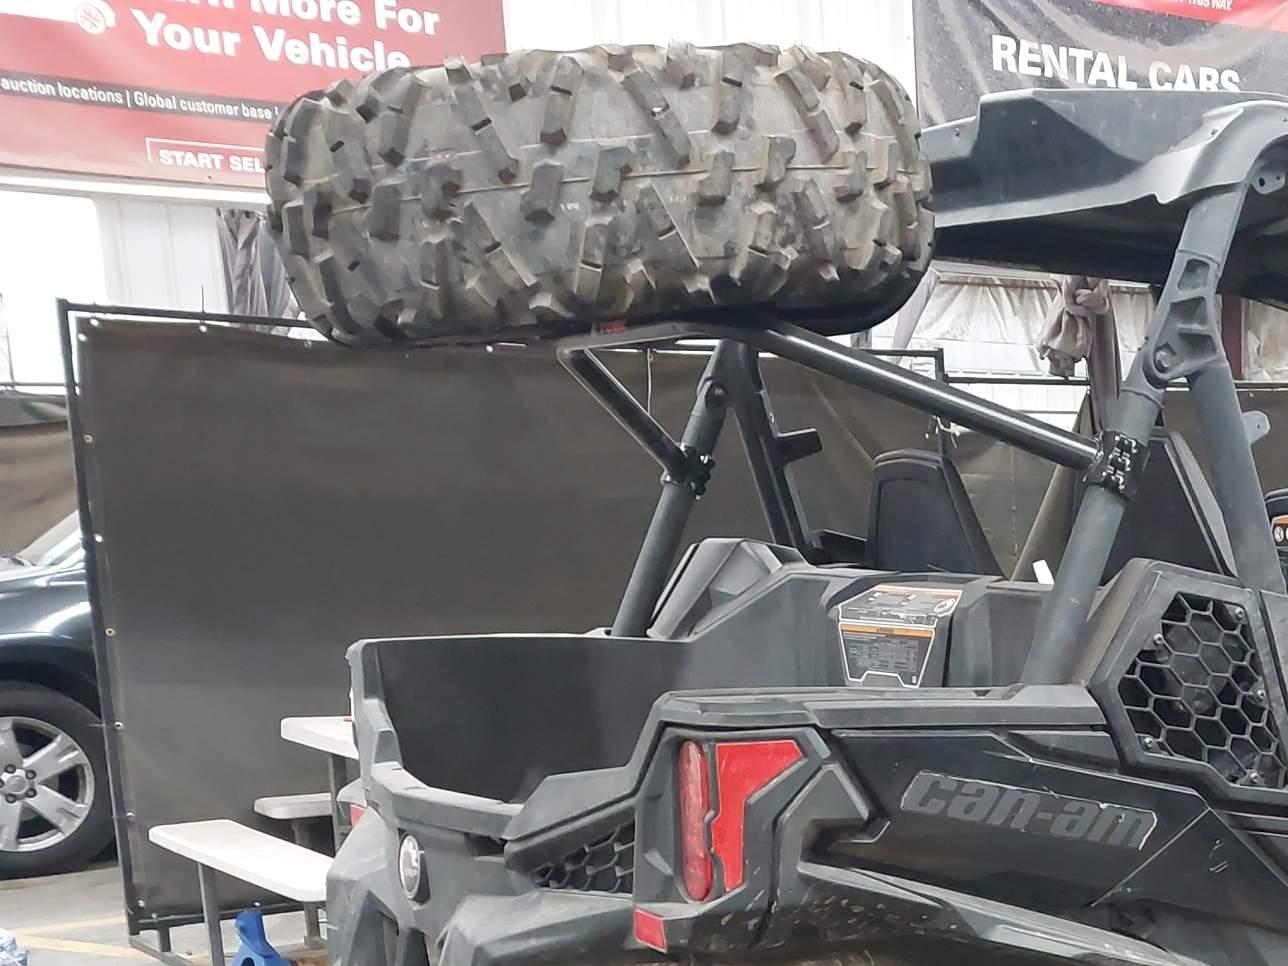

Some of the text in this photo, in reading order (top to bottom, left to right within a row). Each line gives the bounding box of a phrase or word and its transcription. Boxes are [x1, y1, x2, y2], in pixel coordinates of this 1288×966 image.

[375, 0, 440, 35] For
[130, 8, 411, 72] Your Vehicle
[991, 34, 1240, 92] RENTAL CARS
[1, 78, 55, 96] auction
[57, 81, 123, 104] locations
[134, 91, 176, 110] Global
[180, 99, 239, 116] customer
[242, 102, 272, 119] base
[159, 149, 224, 170] START
